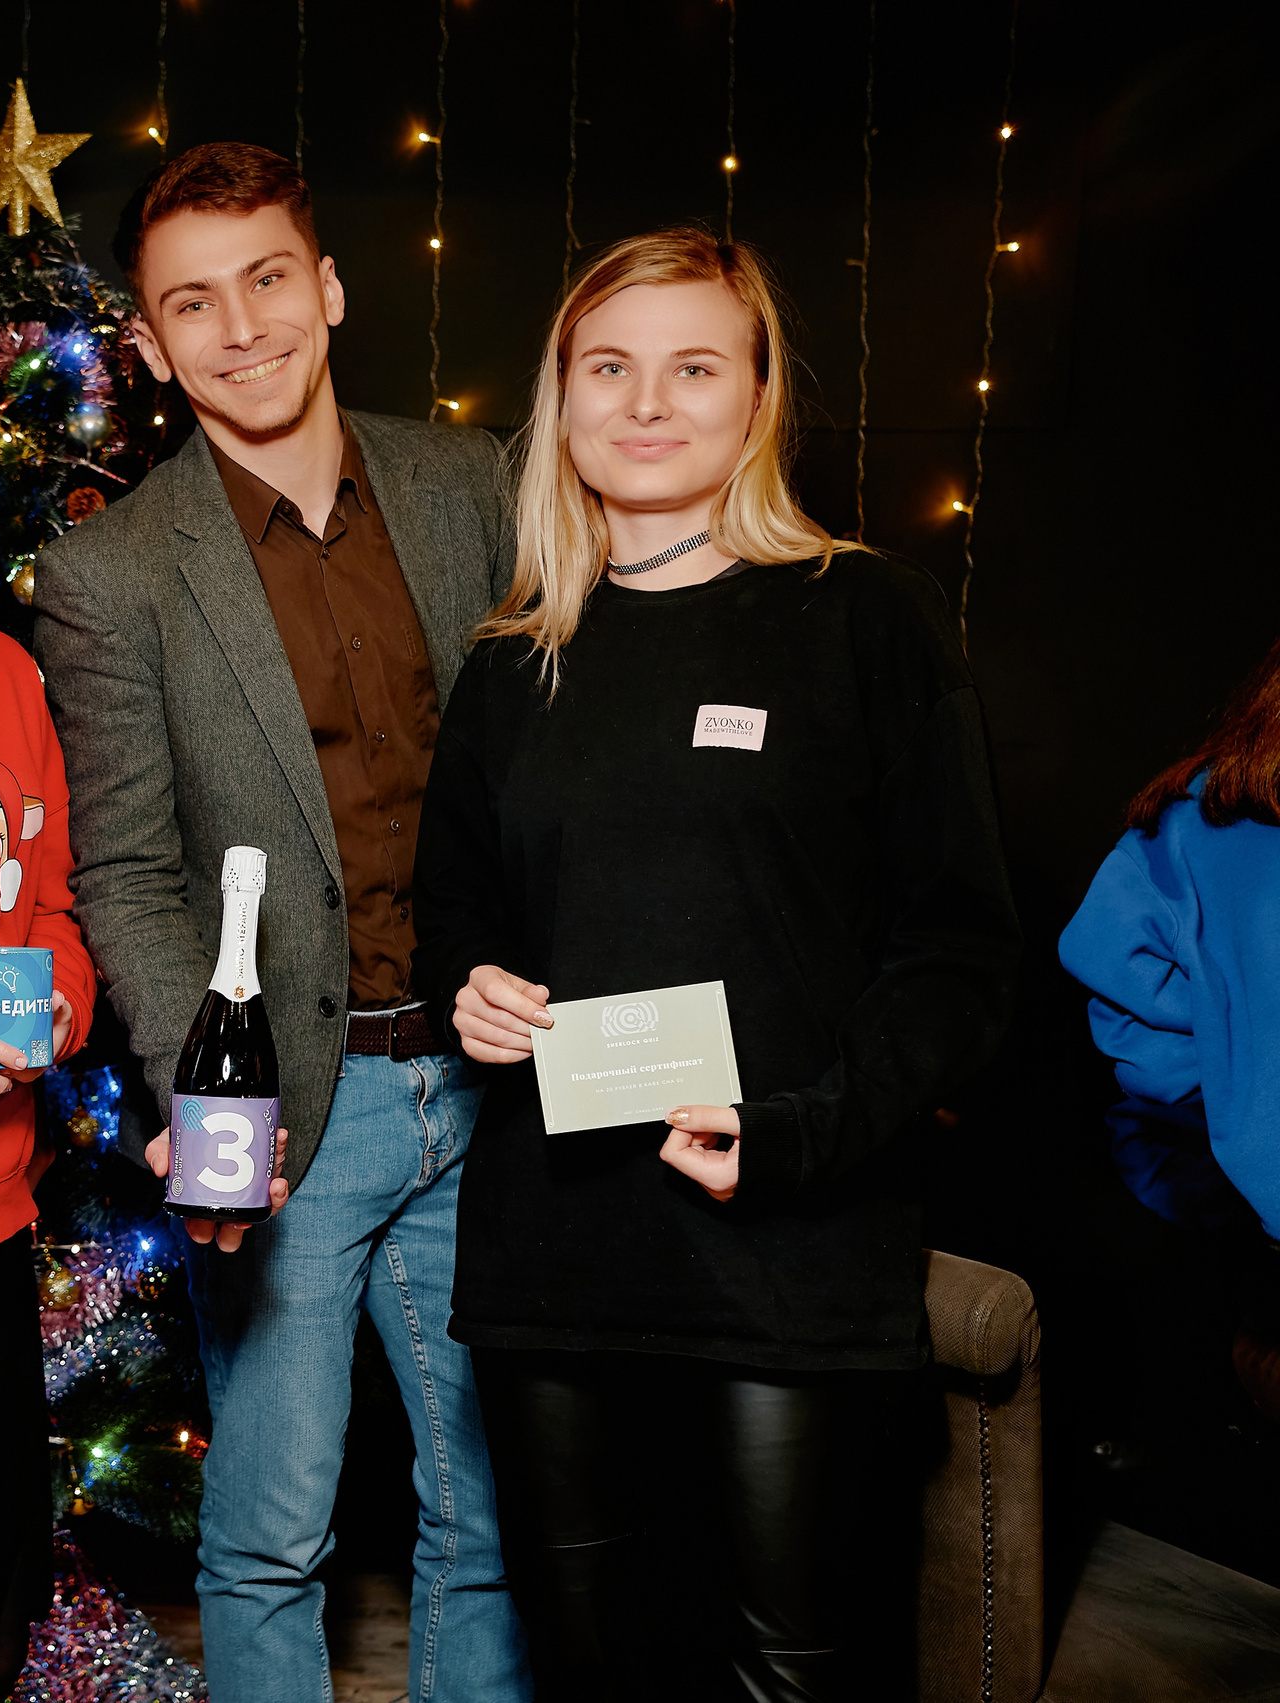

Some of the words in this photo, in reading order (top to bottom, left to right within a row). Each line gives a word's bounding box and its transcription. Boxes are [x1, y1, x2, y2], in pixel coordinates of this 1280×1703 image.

[705, 717, 754, 730] ZVONKO
[606, 1039, 641, 1048] SHERLOCK
[571, 1065, 637, 1081] Подарочный
[639, 1058, 704, 1072] сертификат
[196, 1112, 256, 1193] 3
[266, 1135, 275, 1178] МЕСТО
